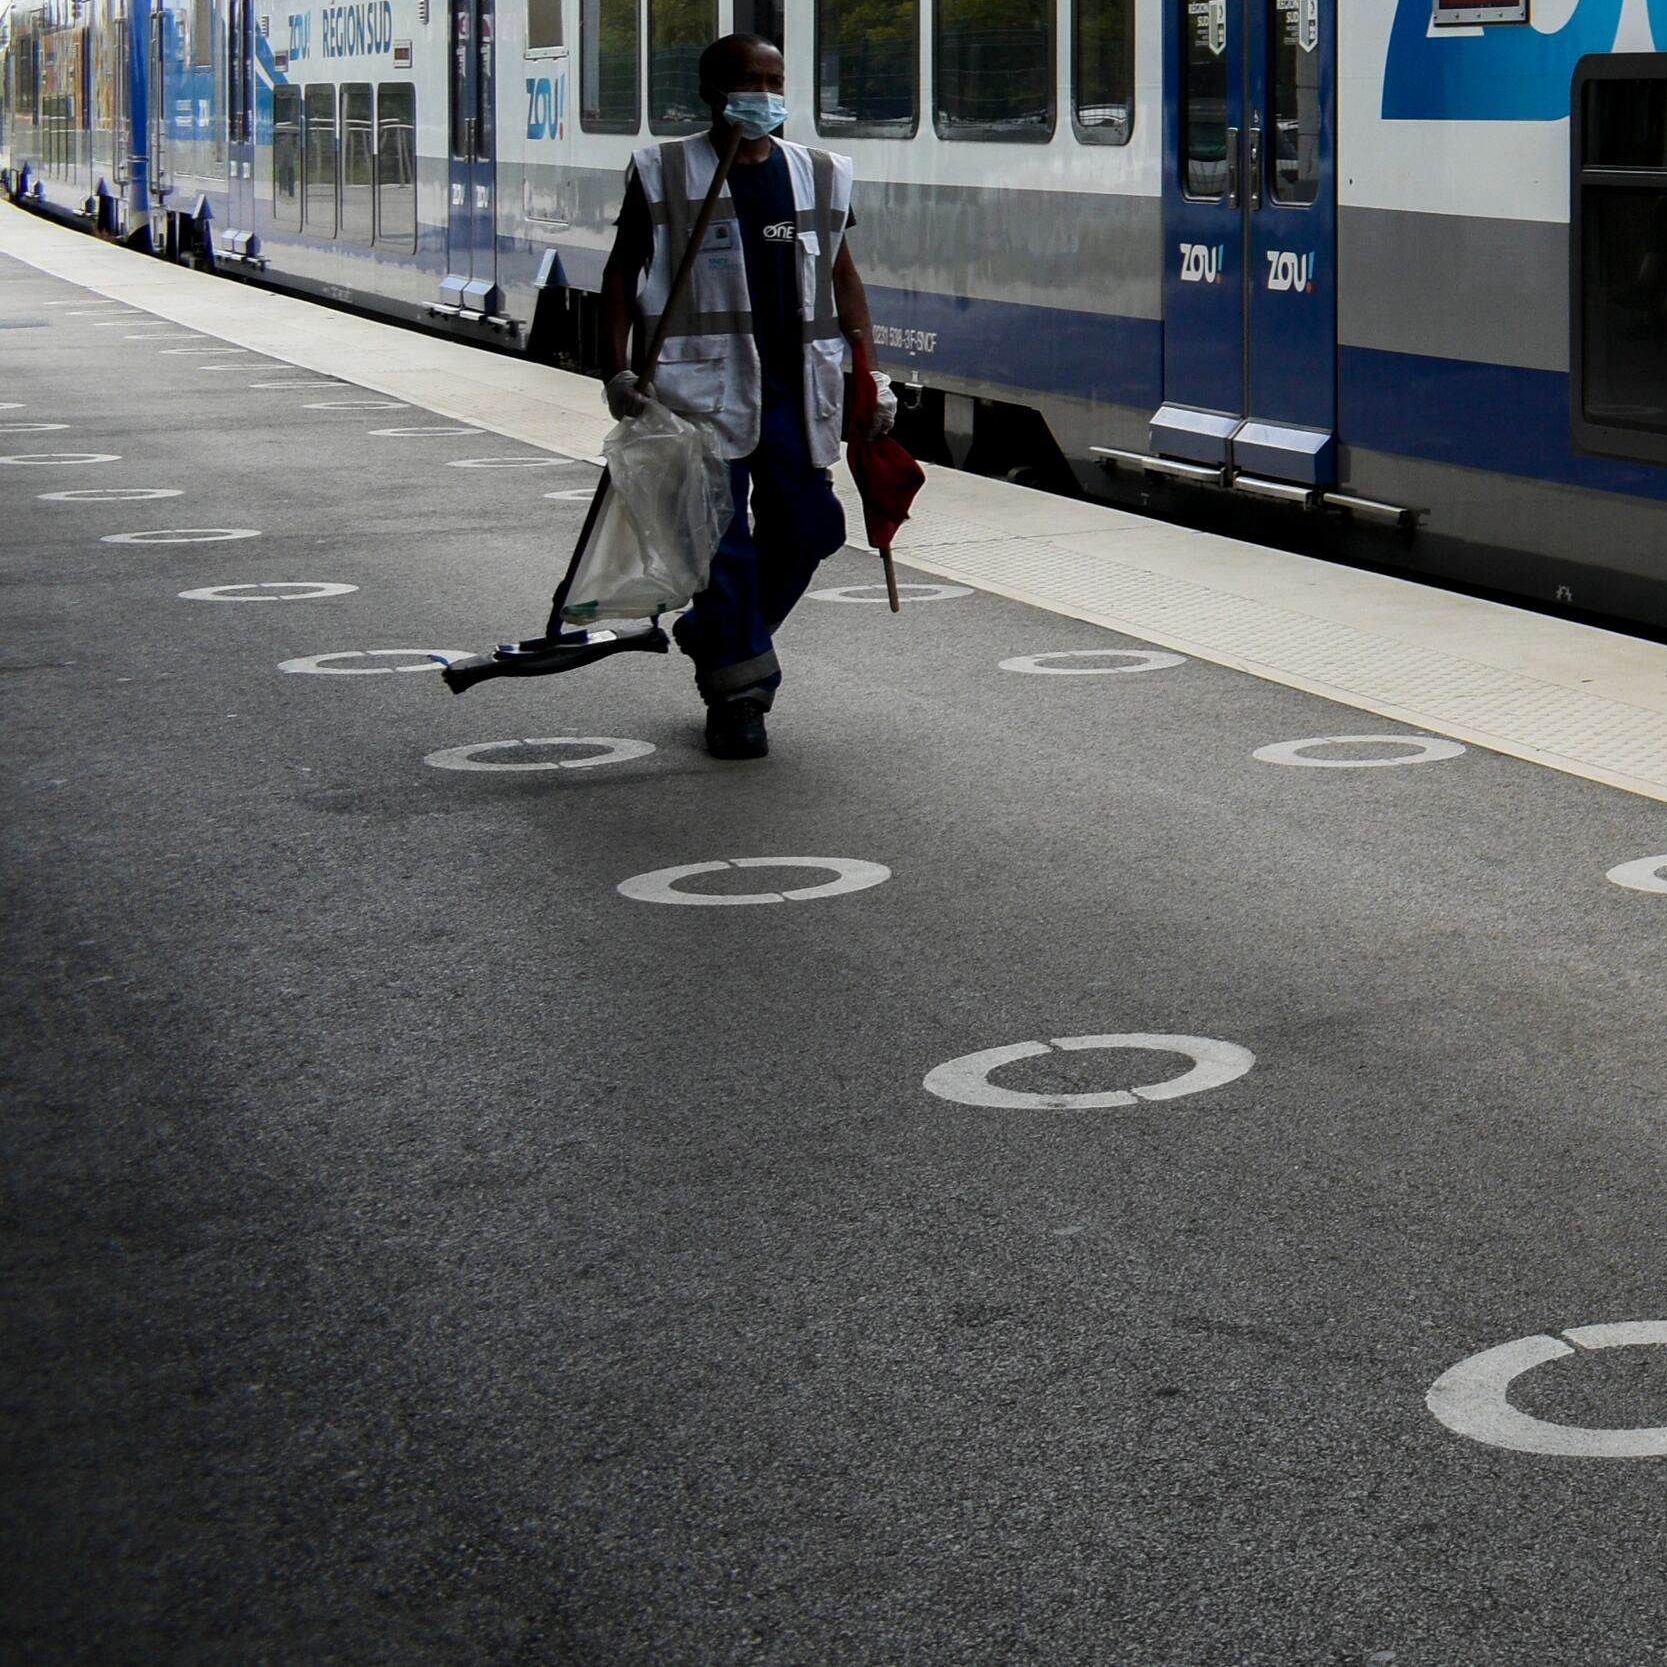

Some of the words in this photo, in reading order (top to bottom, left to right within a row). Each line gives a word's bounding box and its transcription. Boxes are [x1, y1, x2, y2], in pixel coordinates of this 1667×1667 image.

[367, 0, 392, 55] SUD
[526, 73, 565, 141] ZOU!
[1179, 243, 1225, 284] ZOU!
[1266, 250, 1316, 294] ZOU!
